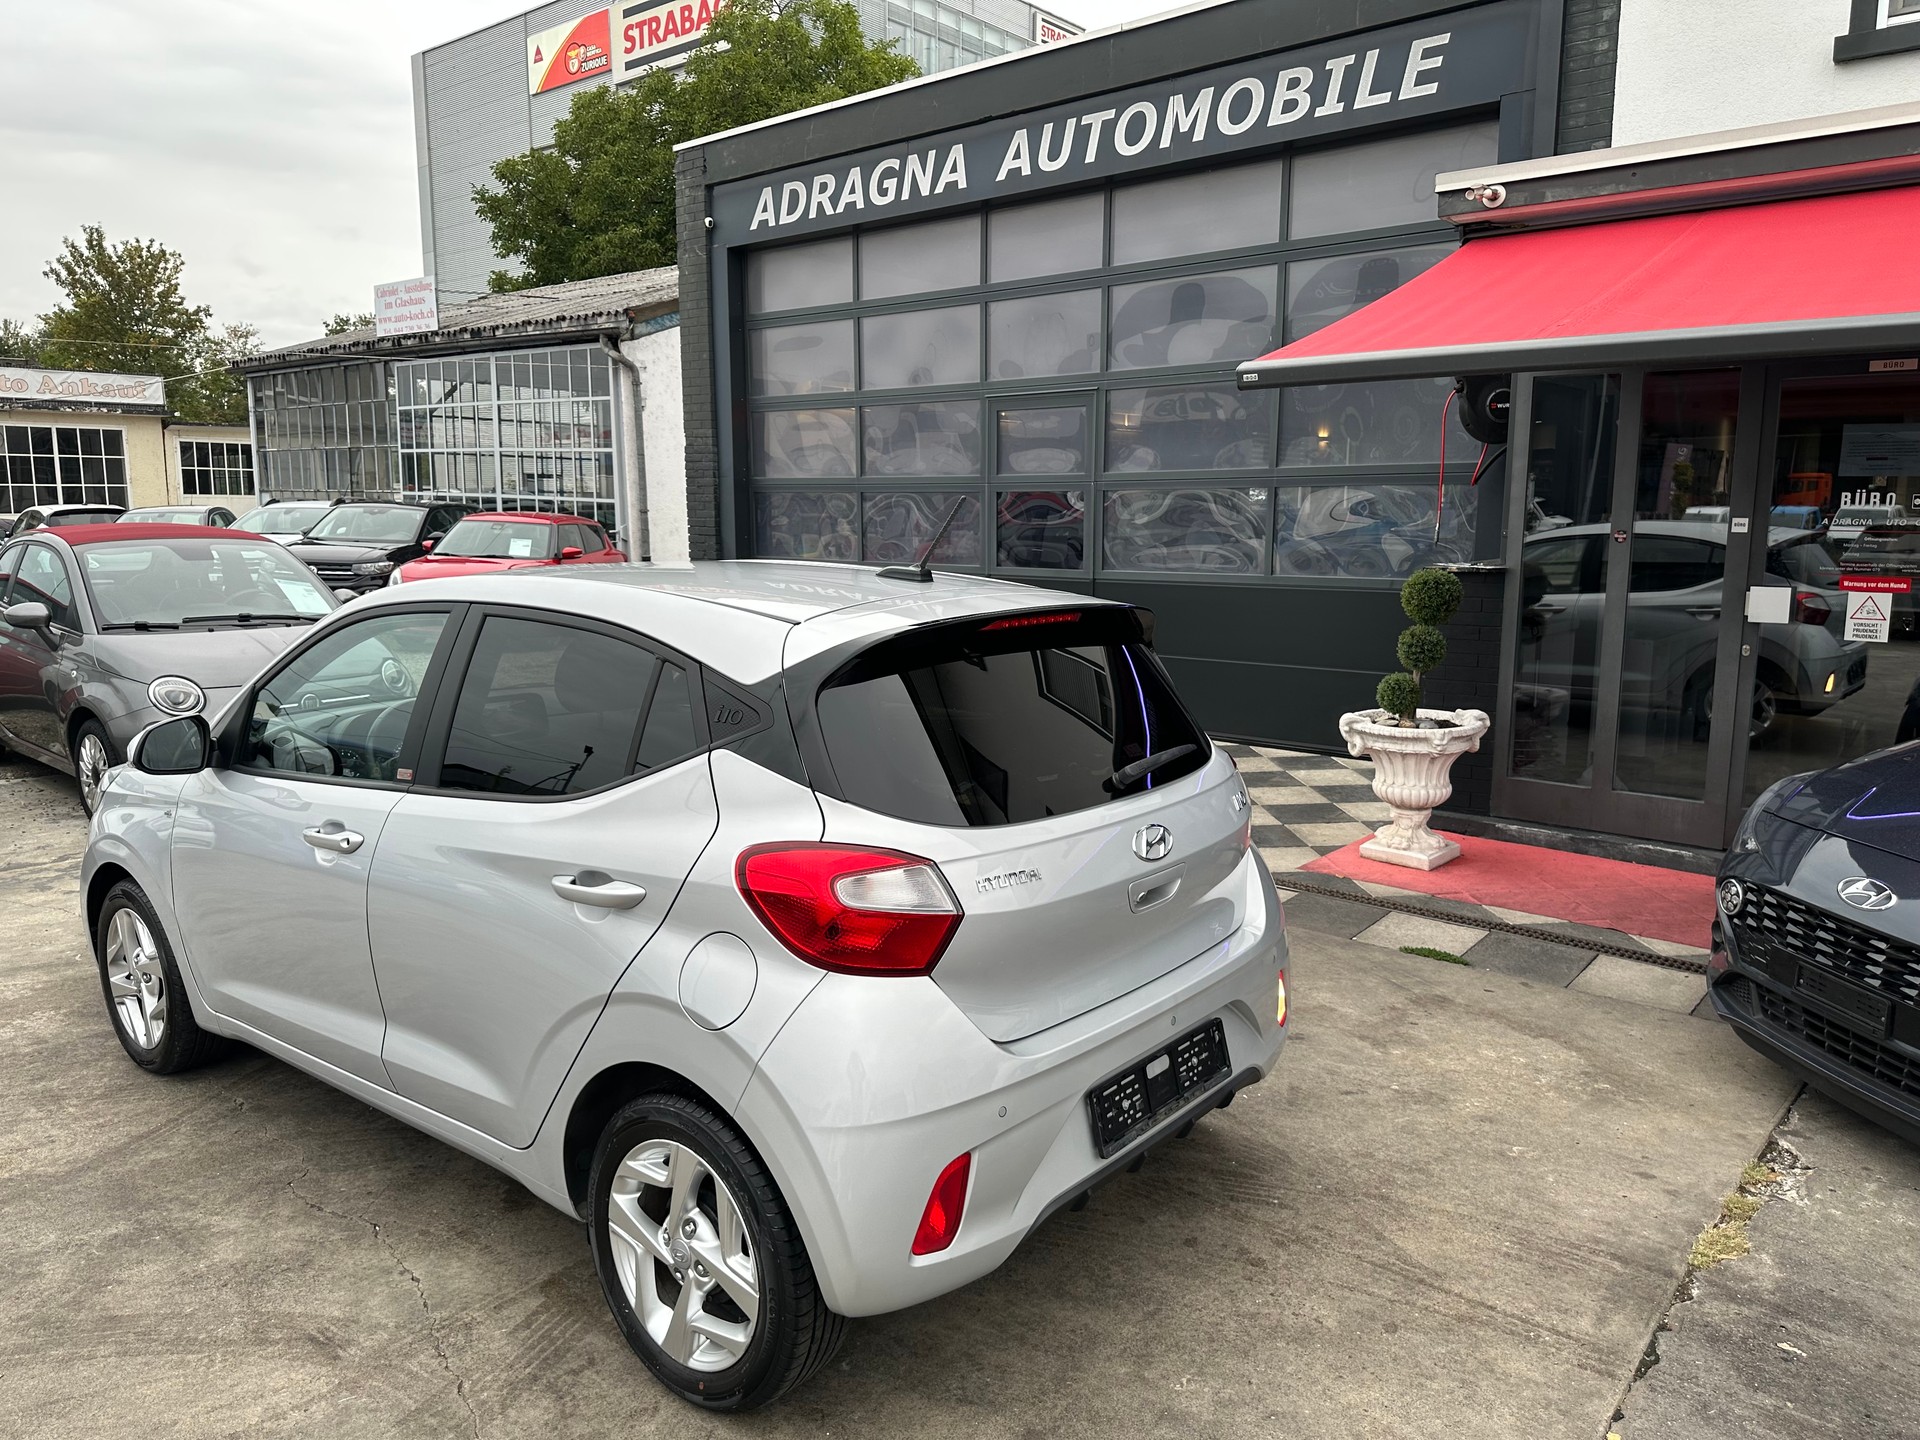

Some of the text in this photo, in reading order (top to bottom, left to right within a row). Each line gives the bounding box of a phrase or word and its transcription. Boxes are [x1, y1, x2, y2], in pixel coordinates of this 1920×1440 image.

[623, 0, 722, 55] STRABA
[581, 55, 608, 72] ZURIQUE
[749, 31, 1451, 232] ADRAGNA AUTOMOBILE
[384, 295, 426, 310] im Glashaus
[378, 307, 435, 324] www.auto-koch.ch
[1882, 360, 1905, 369] BÜRO
[36, 374, 148, 399] Ankauf
[1840, 489, 1897, 508] BÜRO
[1843, 580, 1867, 588] Warnung
[713, 704, 744, 725] i10
[975, 867, 1043, 893] HYUNDAI
